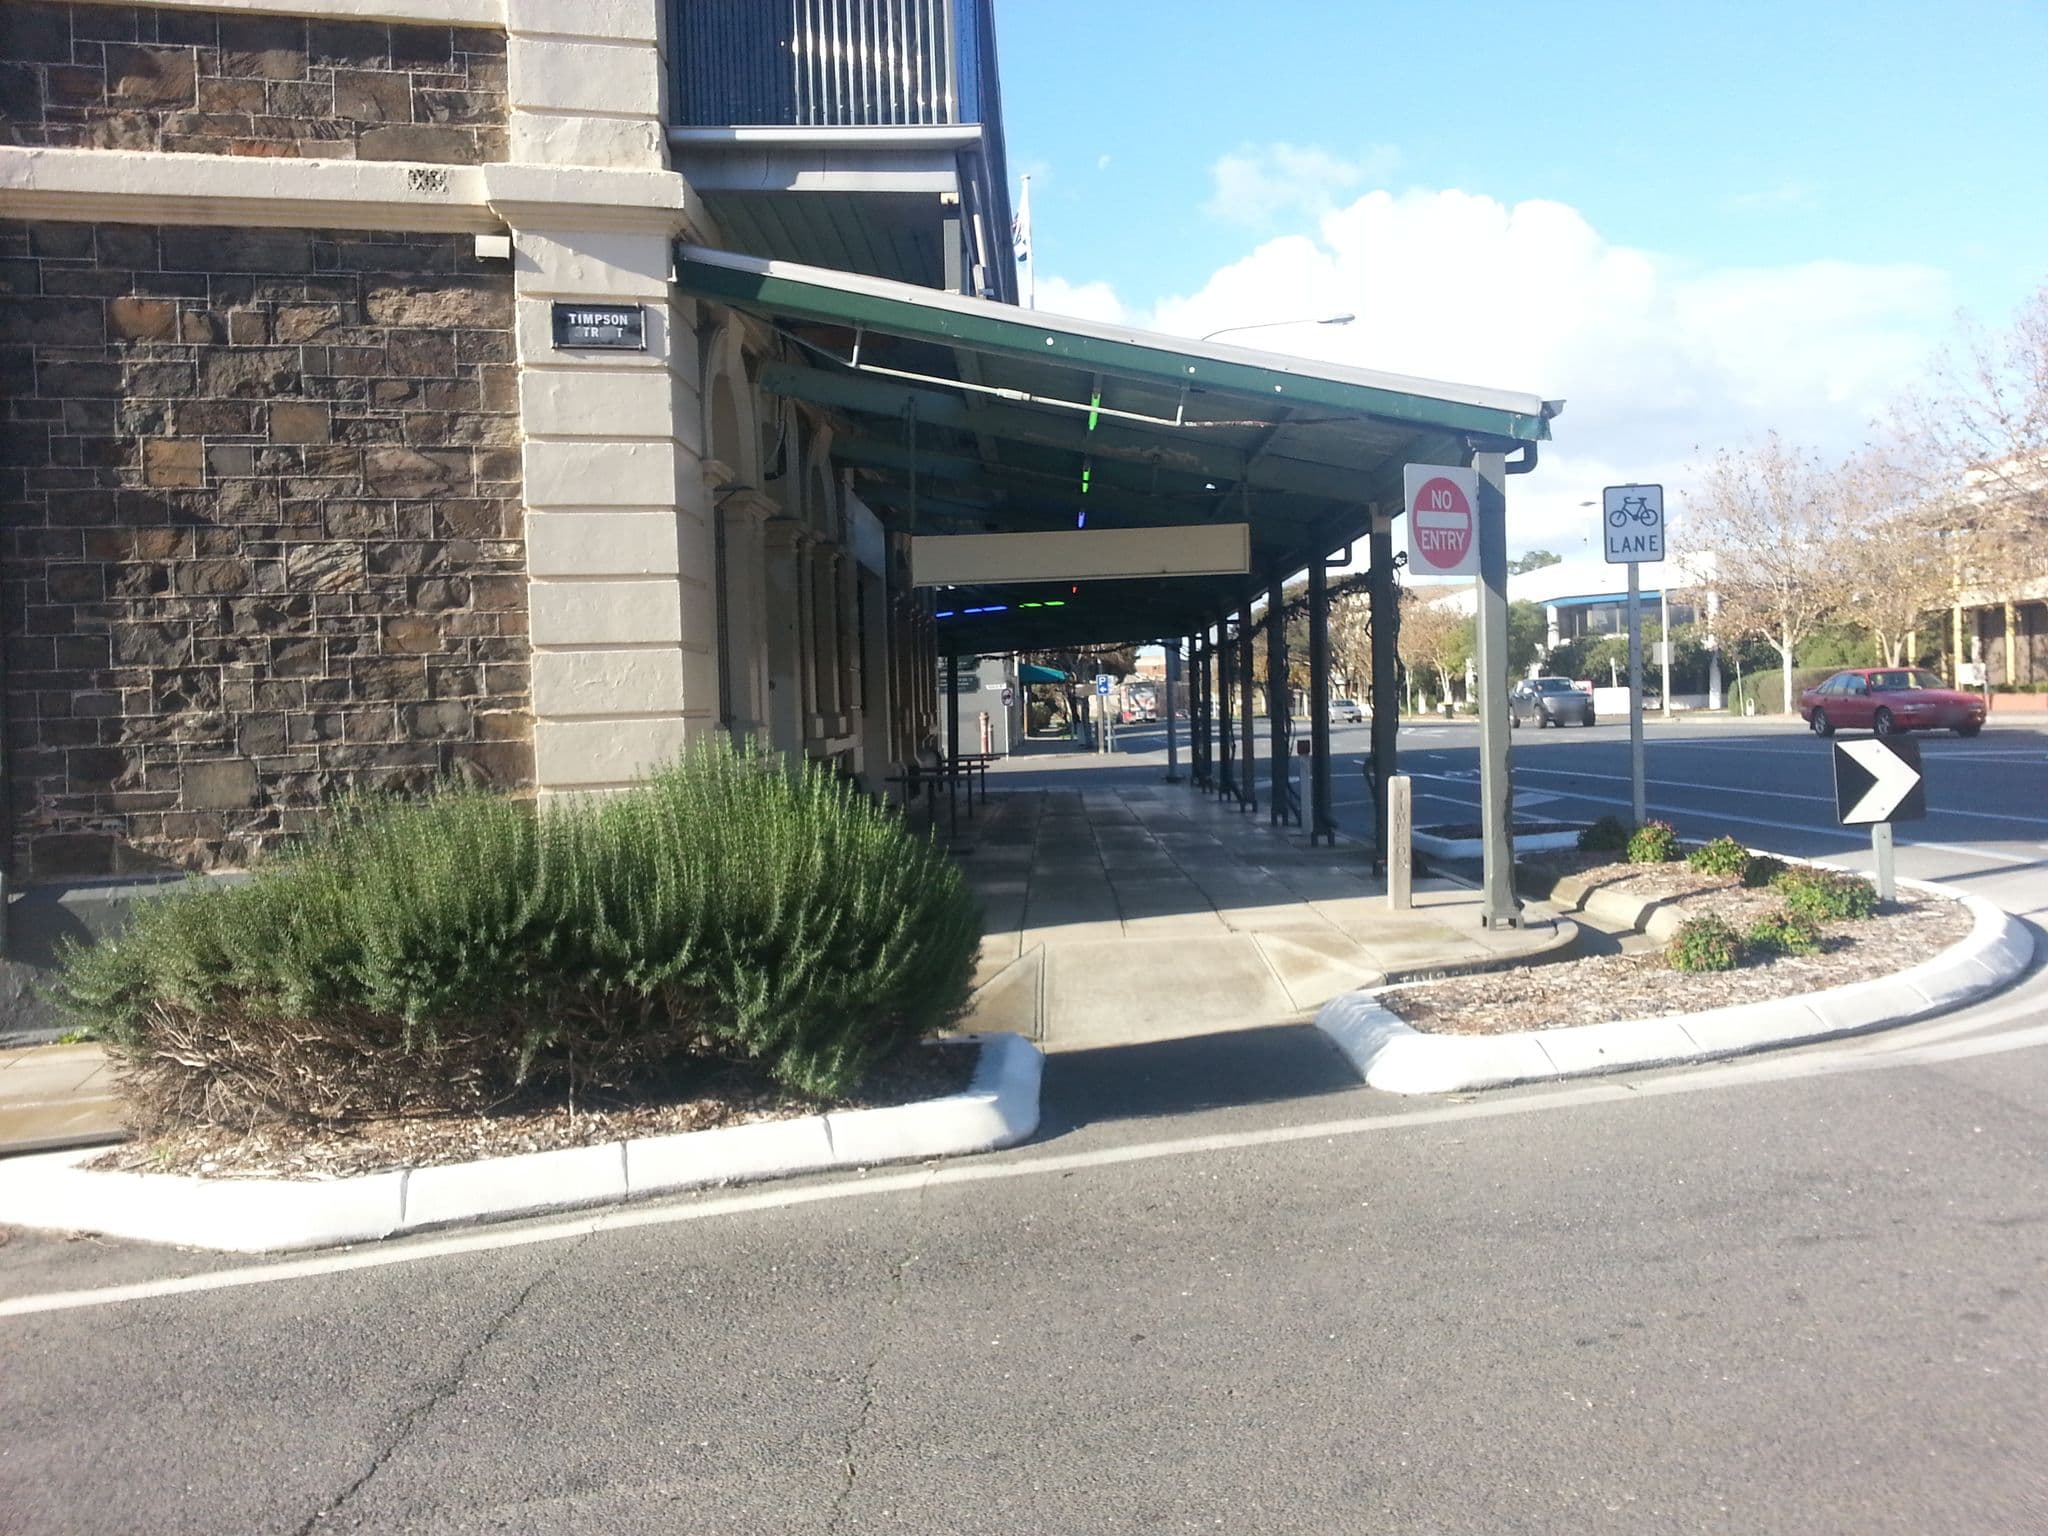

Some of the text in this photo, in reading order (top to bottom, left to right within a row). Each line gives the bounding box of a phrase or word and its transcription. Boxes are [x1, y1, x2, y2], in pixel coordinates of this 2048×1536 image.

[568, 313, 629, 325] TIMPSON
[1431, 489, 1452, 510] NO
[1421, 530, 1466, 551] ENTRY
[1610, 535, 1659, 553] LANE
